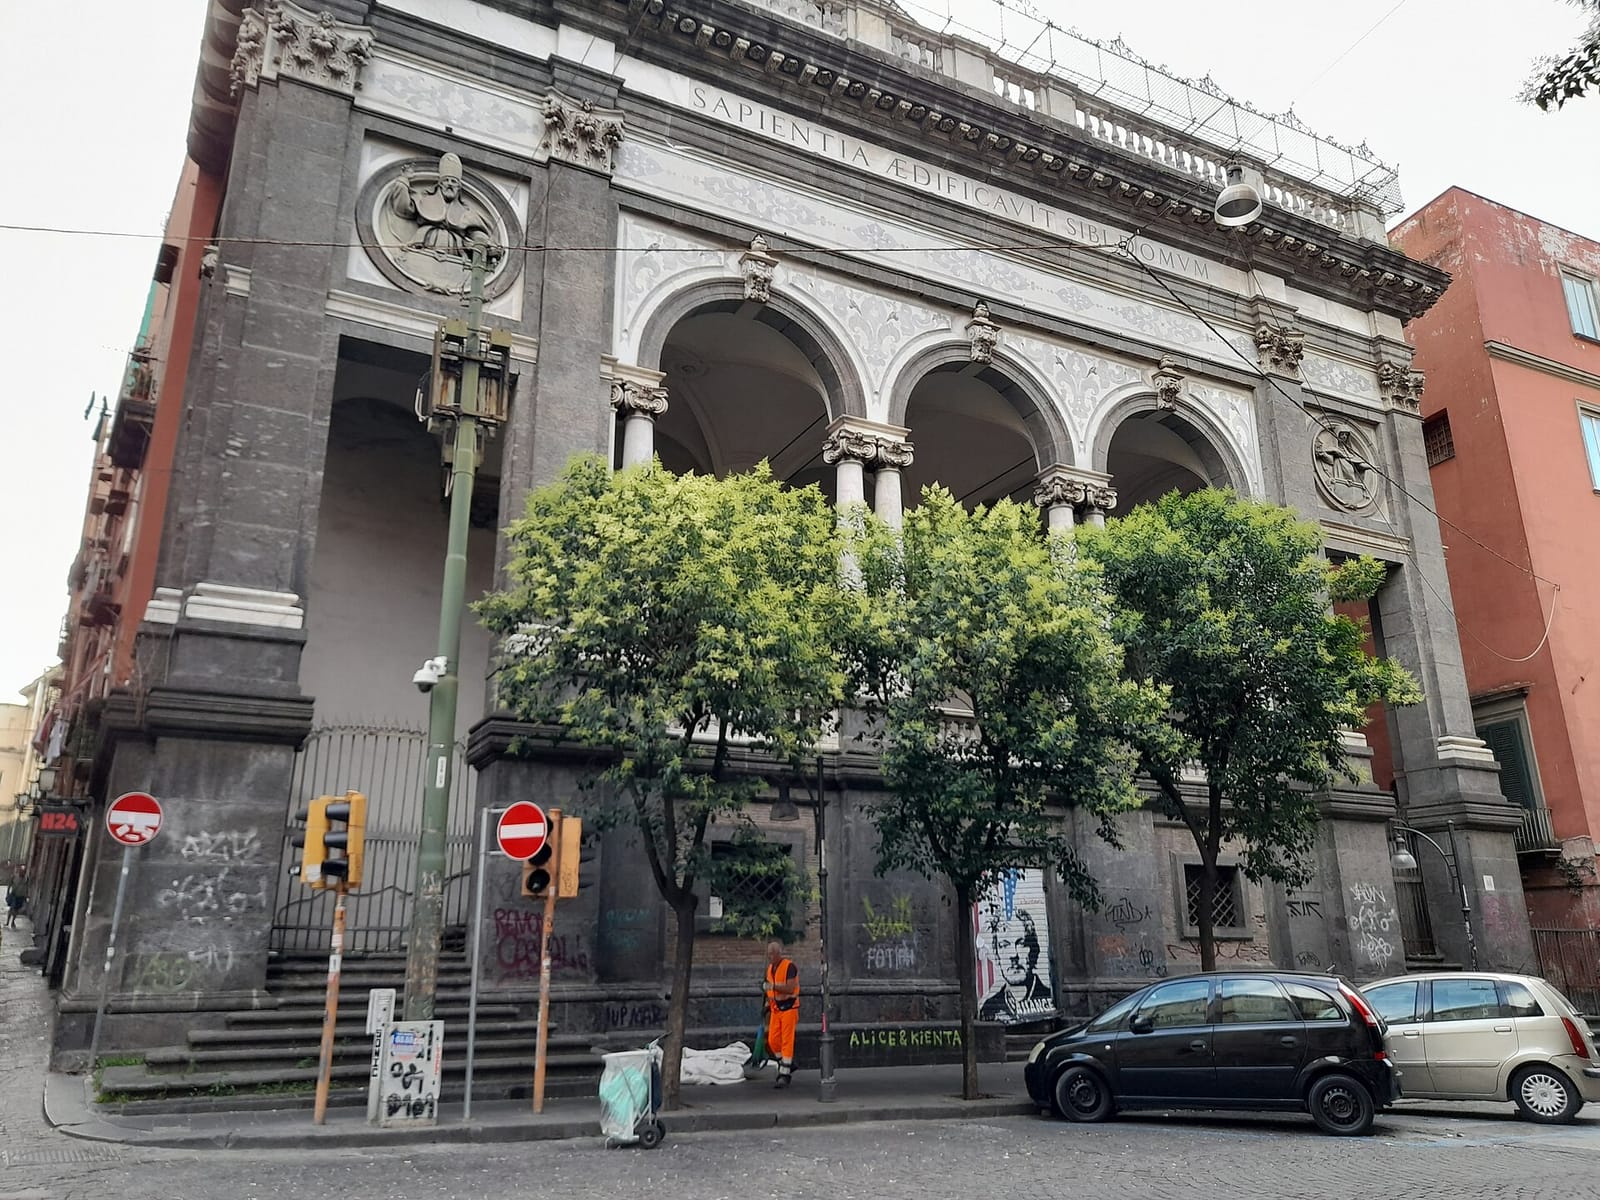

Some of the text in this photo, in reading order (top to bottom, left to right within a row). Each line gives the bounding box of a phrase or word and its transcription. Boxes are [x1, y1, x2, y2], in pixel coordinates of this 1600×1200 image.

[693, 87, 870, 167] SAPIENTIA
[886, 158, 1056, 228] ÆDIFICAVIT
[1066, 216, 1107, 247] SIBI
[41, 812, 78, 830] H24
